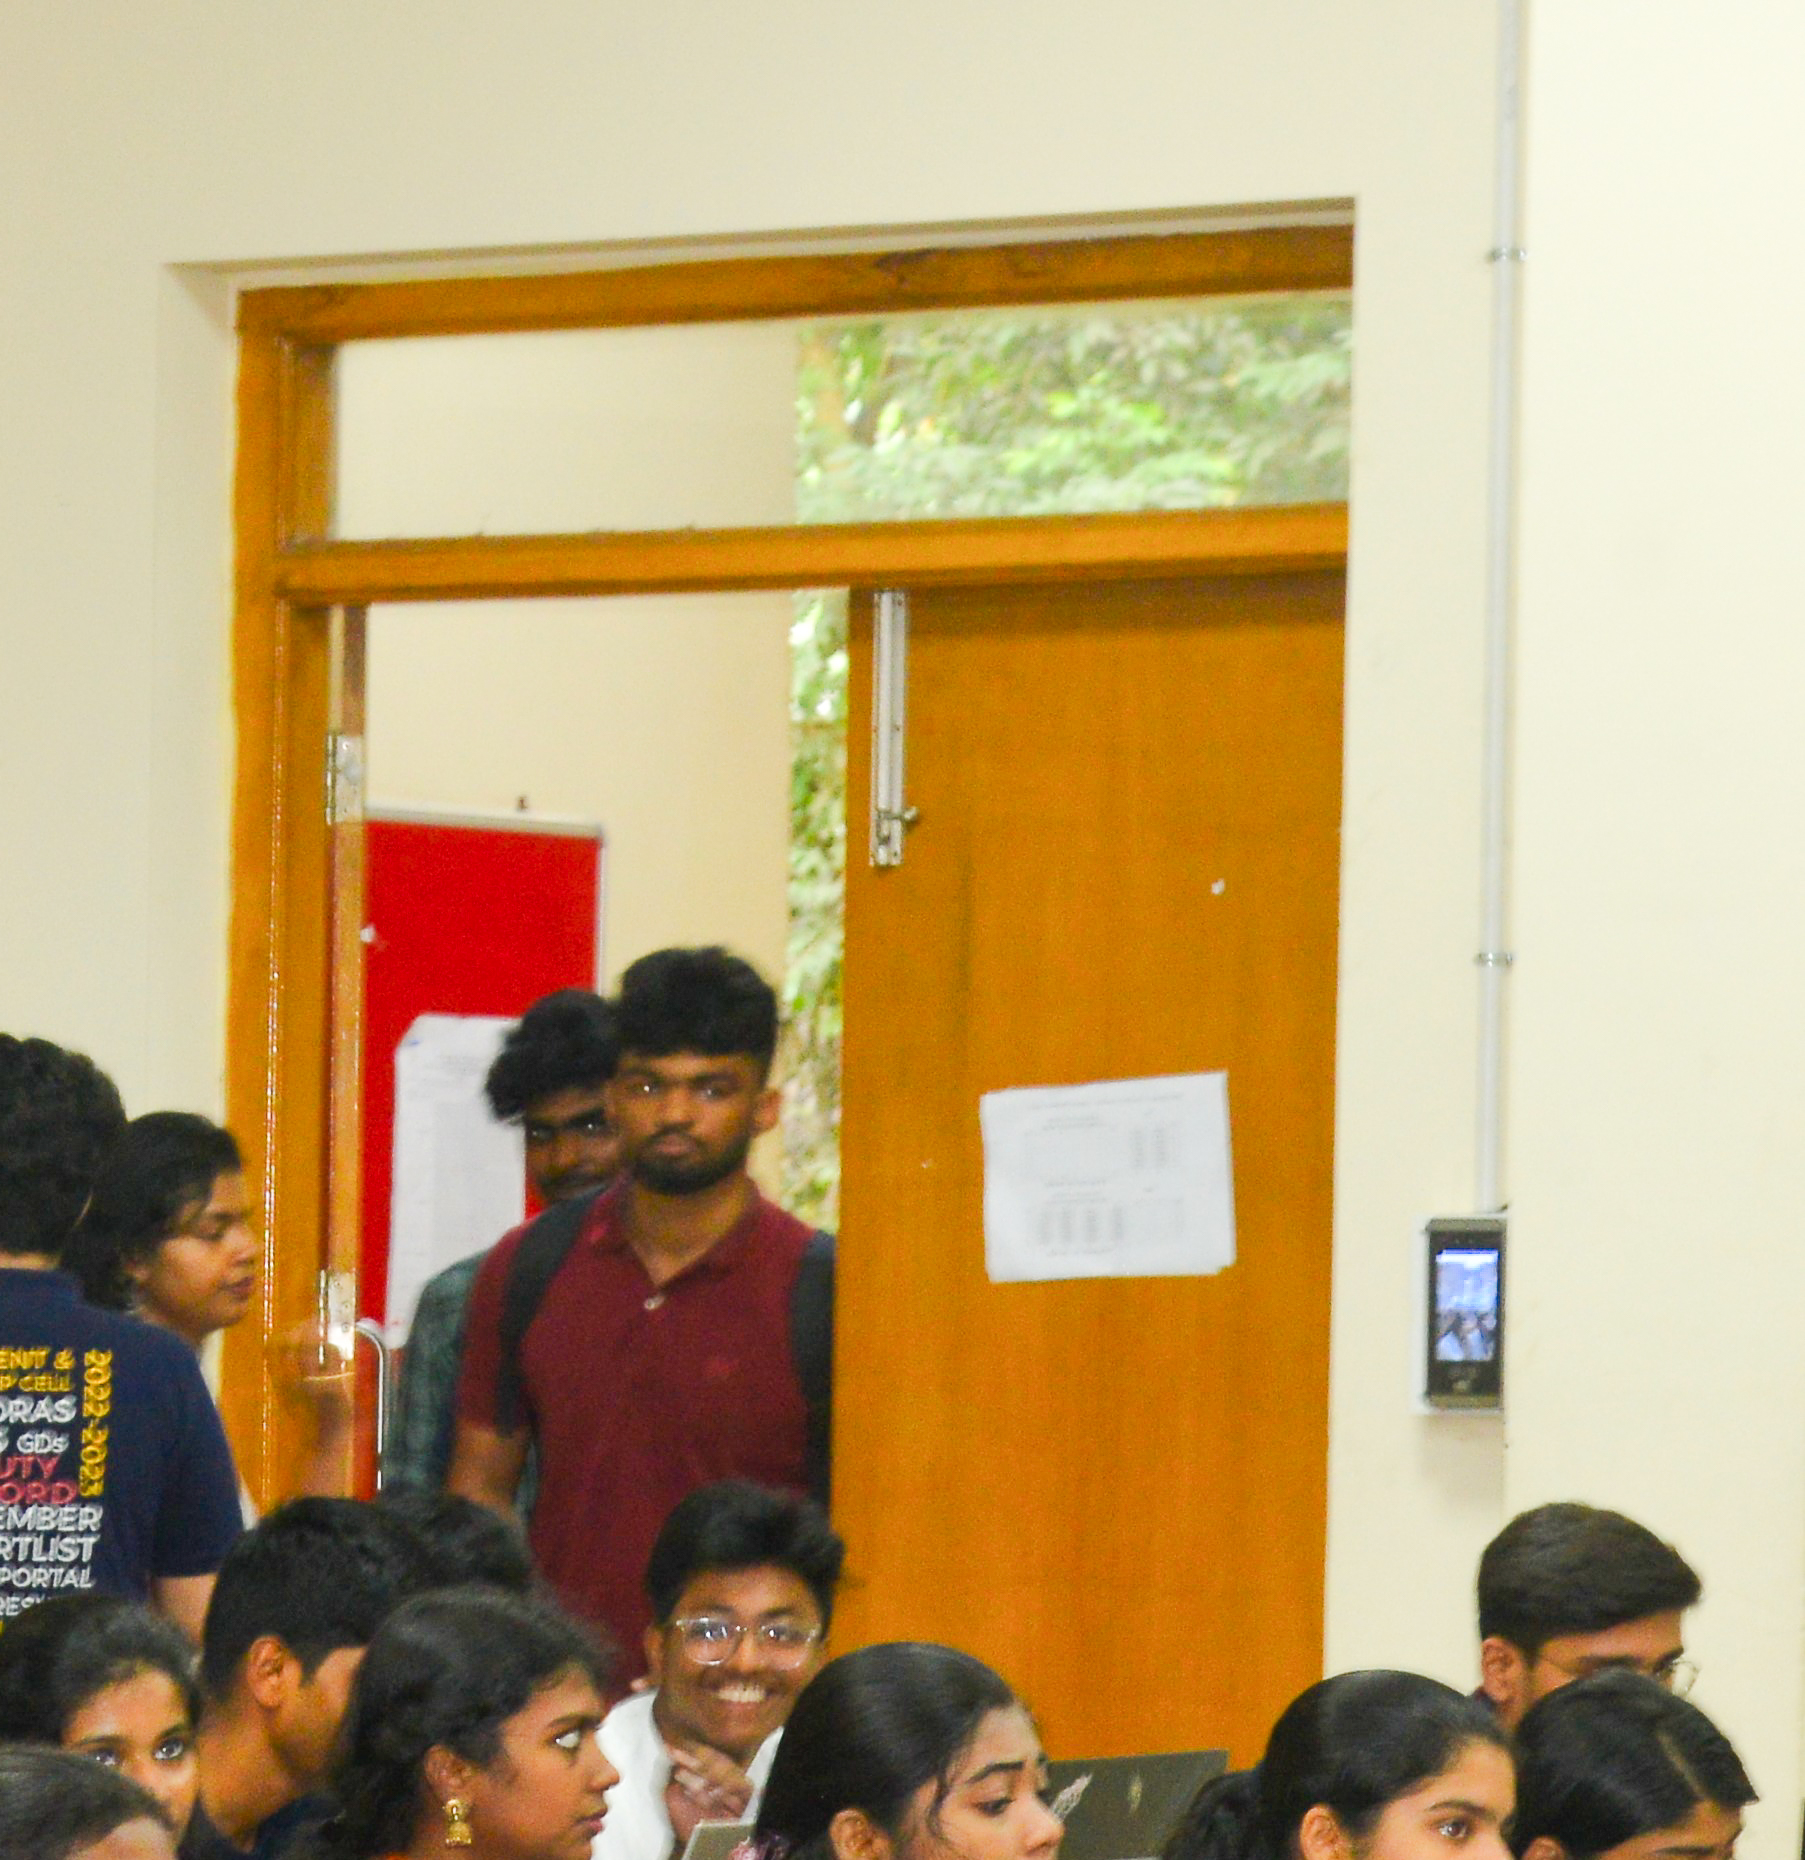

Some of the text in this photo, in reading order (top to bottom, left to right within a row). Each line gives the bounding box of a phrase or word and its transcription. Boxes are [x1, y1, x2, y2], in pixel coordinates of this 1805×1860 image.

[53, 1347, 75, 1371] &
[18, 1372, 74, 1393] CELL
[80, 1348, 112, 1497] 2022-2023
